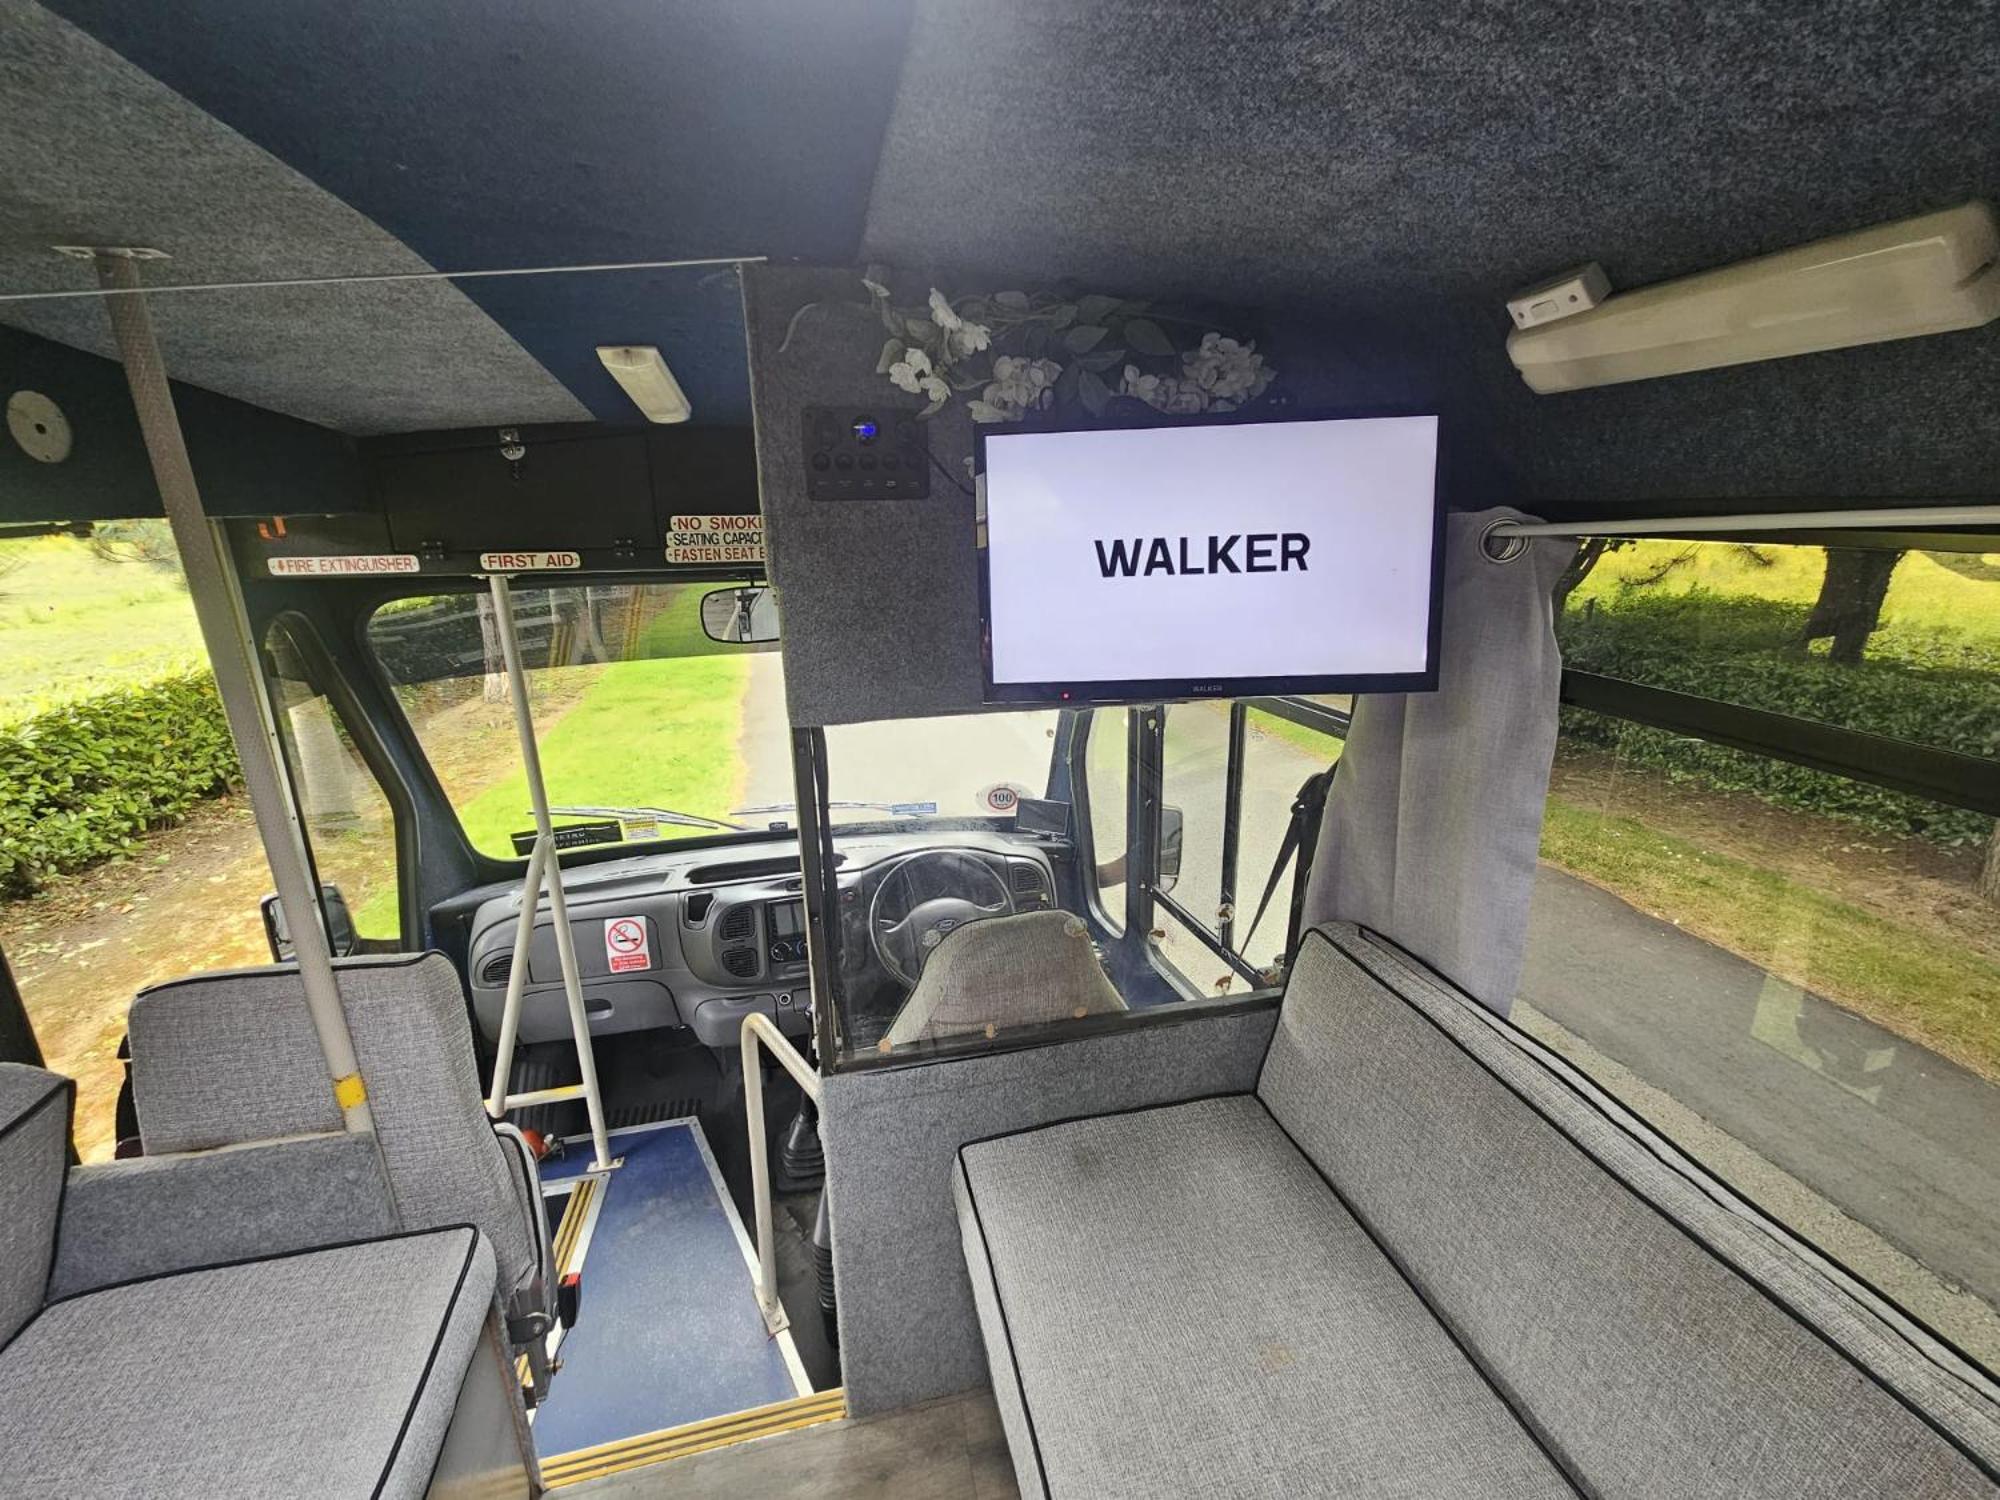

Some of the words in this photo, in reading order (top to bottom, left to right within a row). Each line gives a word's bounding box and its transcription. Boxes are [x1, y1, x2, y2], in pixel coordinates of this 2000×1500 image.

[678, 516, 702, 530] NO
[710, 516, 762, 530] SMOKI
[673, 532, 720, 546] SEATING
[487, 554, 537, 568] FIRST
[546, 554, 574, 567] AID
[674, 548, 721, 561] FASTEN
[725, 547, 755, 560] SEAT
[1094, 533, 1311, 578] WALKER
[287, 559, 315, 573] FIRE
[319, 557, 414, 573] EXTINGUISHER
[991, 792, 1013, 803] 100
